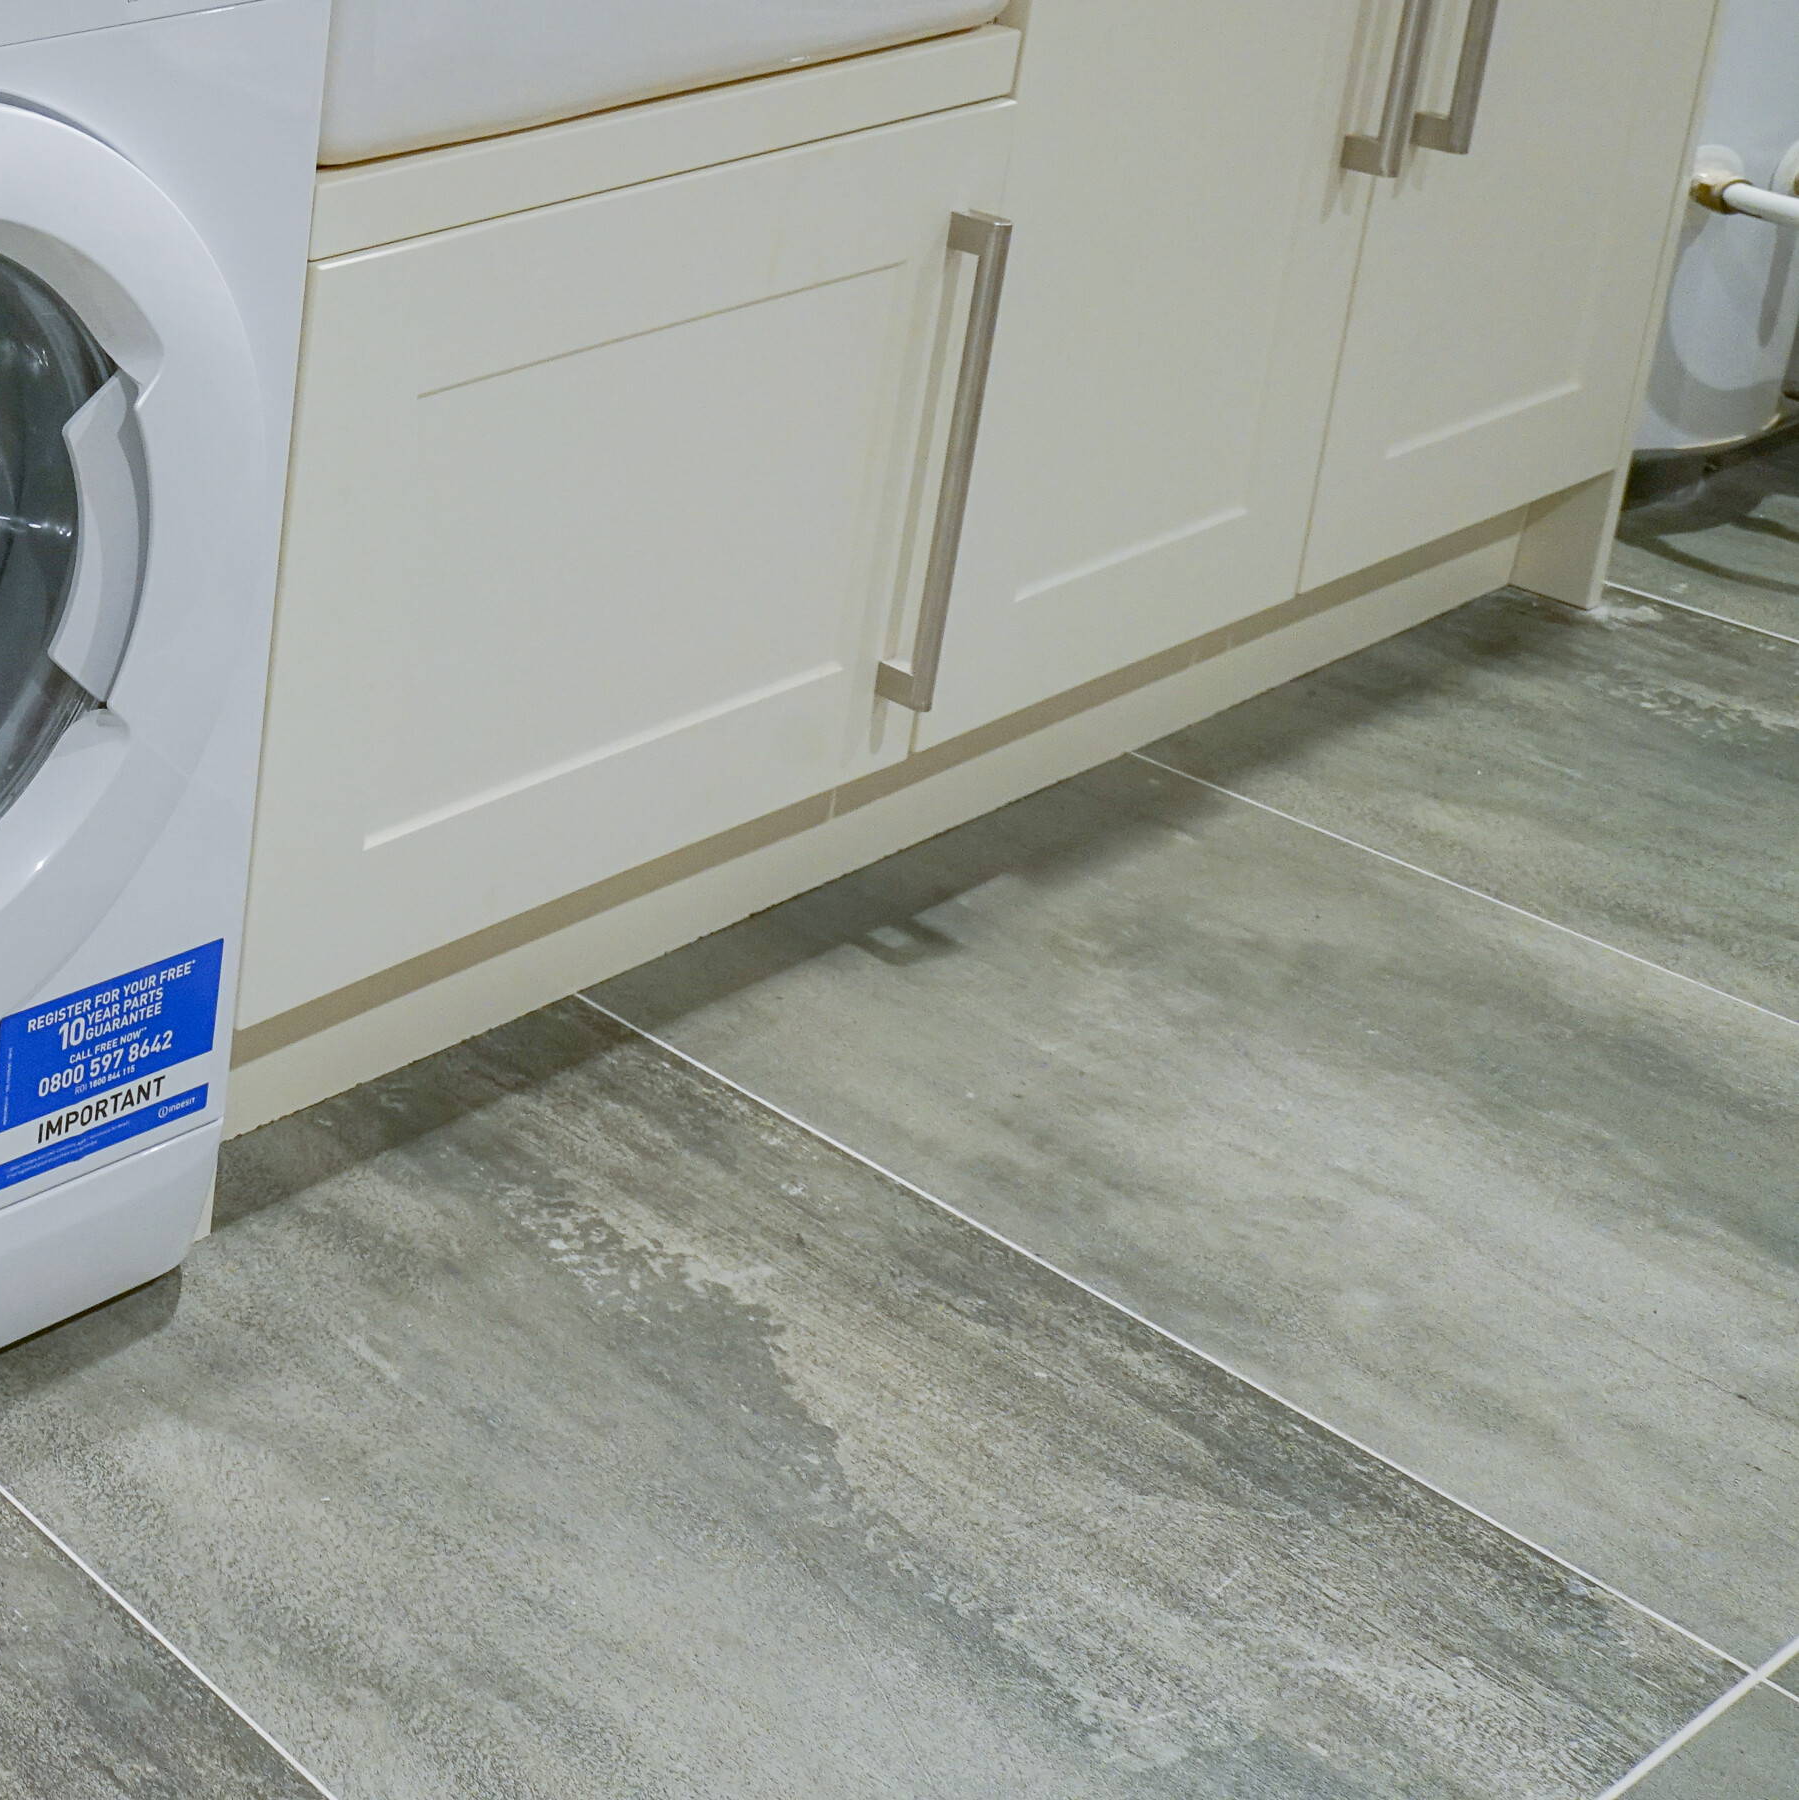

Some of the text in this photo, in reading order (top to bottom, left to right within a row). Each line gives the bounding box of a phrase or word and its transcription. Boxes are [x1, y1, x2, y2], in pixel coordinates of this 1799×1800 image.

[27, 999, 92, 1033] REGISTER
[94, 988, 120, 1009] FOR
[123, 974, 157, 997] YOUR
[58, 987, 164, 1050] 10 YEAR PARTS
[85, 1001, 163, 1041] GUARANTEE
[38, 1063, 85, 1097] 0800
[89, 1048, 124, 1077] 597
[128, 1029, 173, 1063] 8642
[69, 1038, 118, 1064] CALL FREE
[37, 1075, 166, 1144] IMPORTANT
[74, 1084, 88, 1095] ROI
